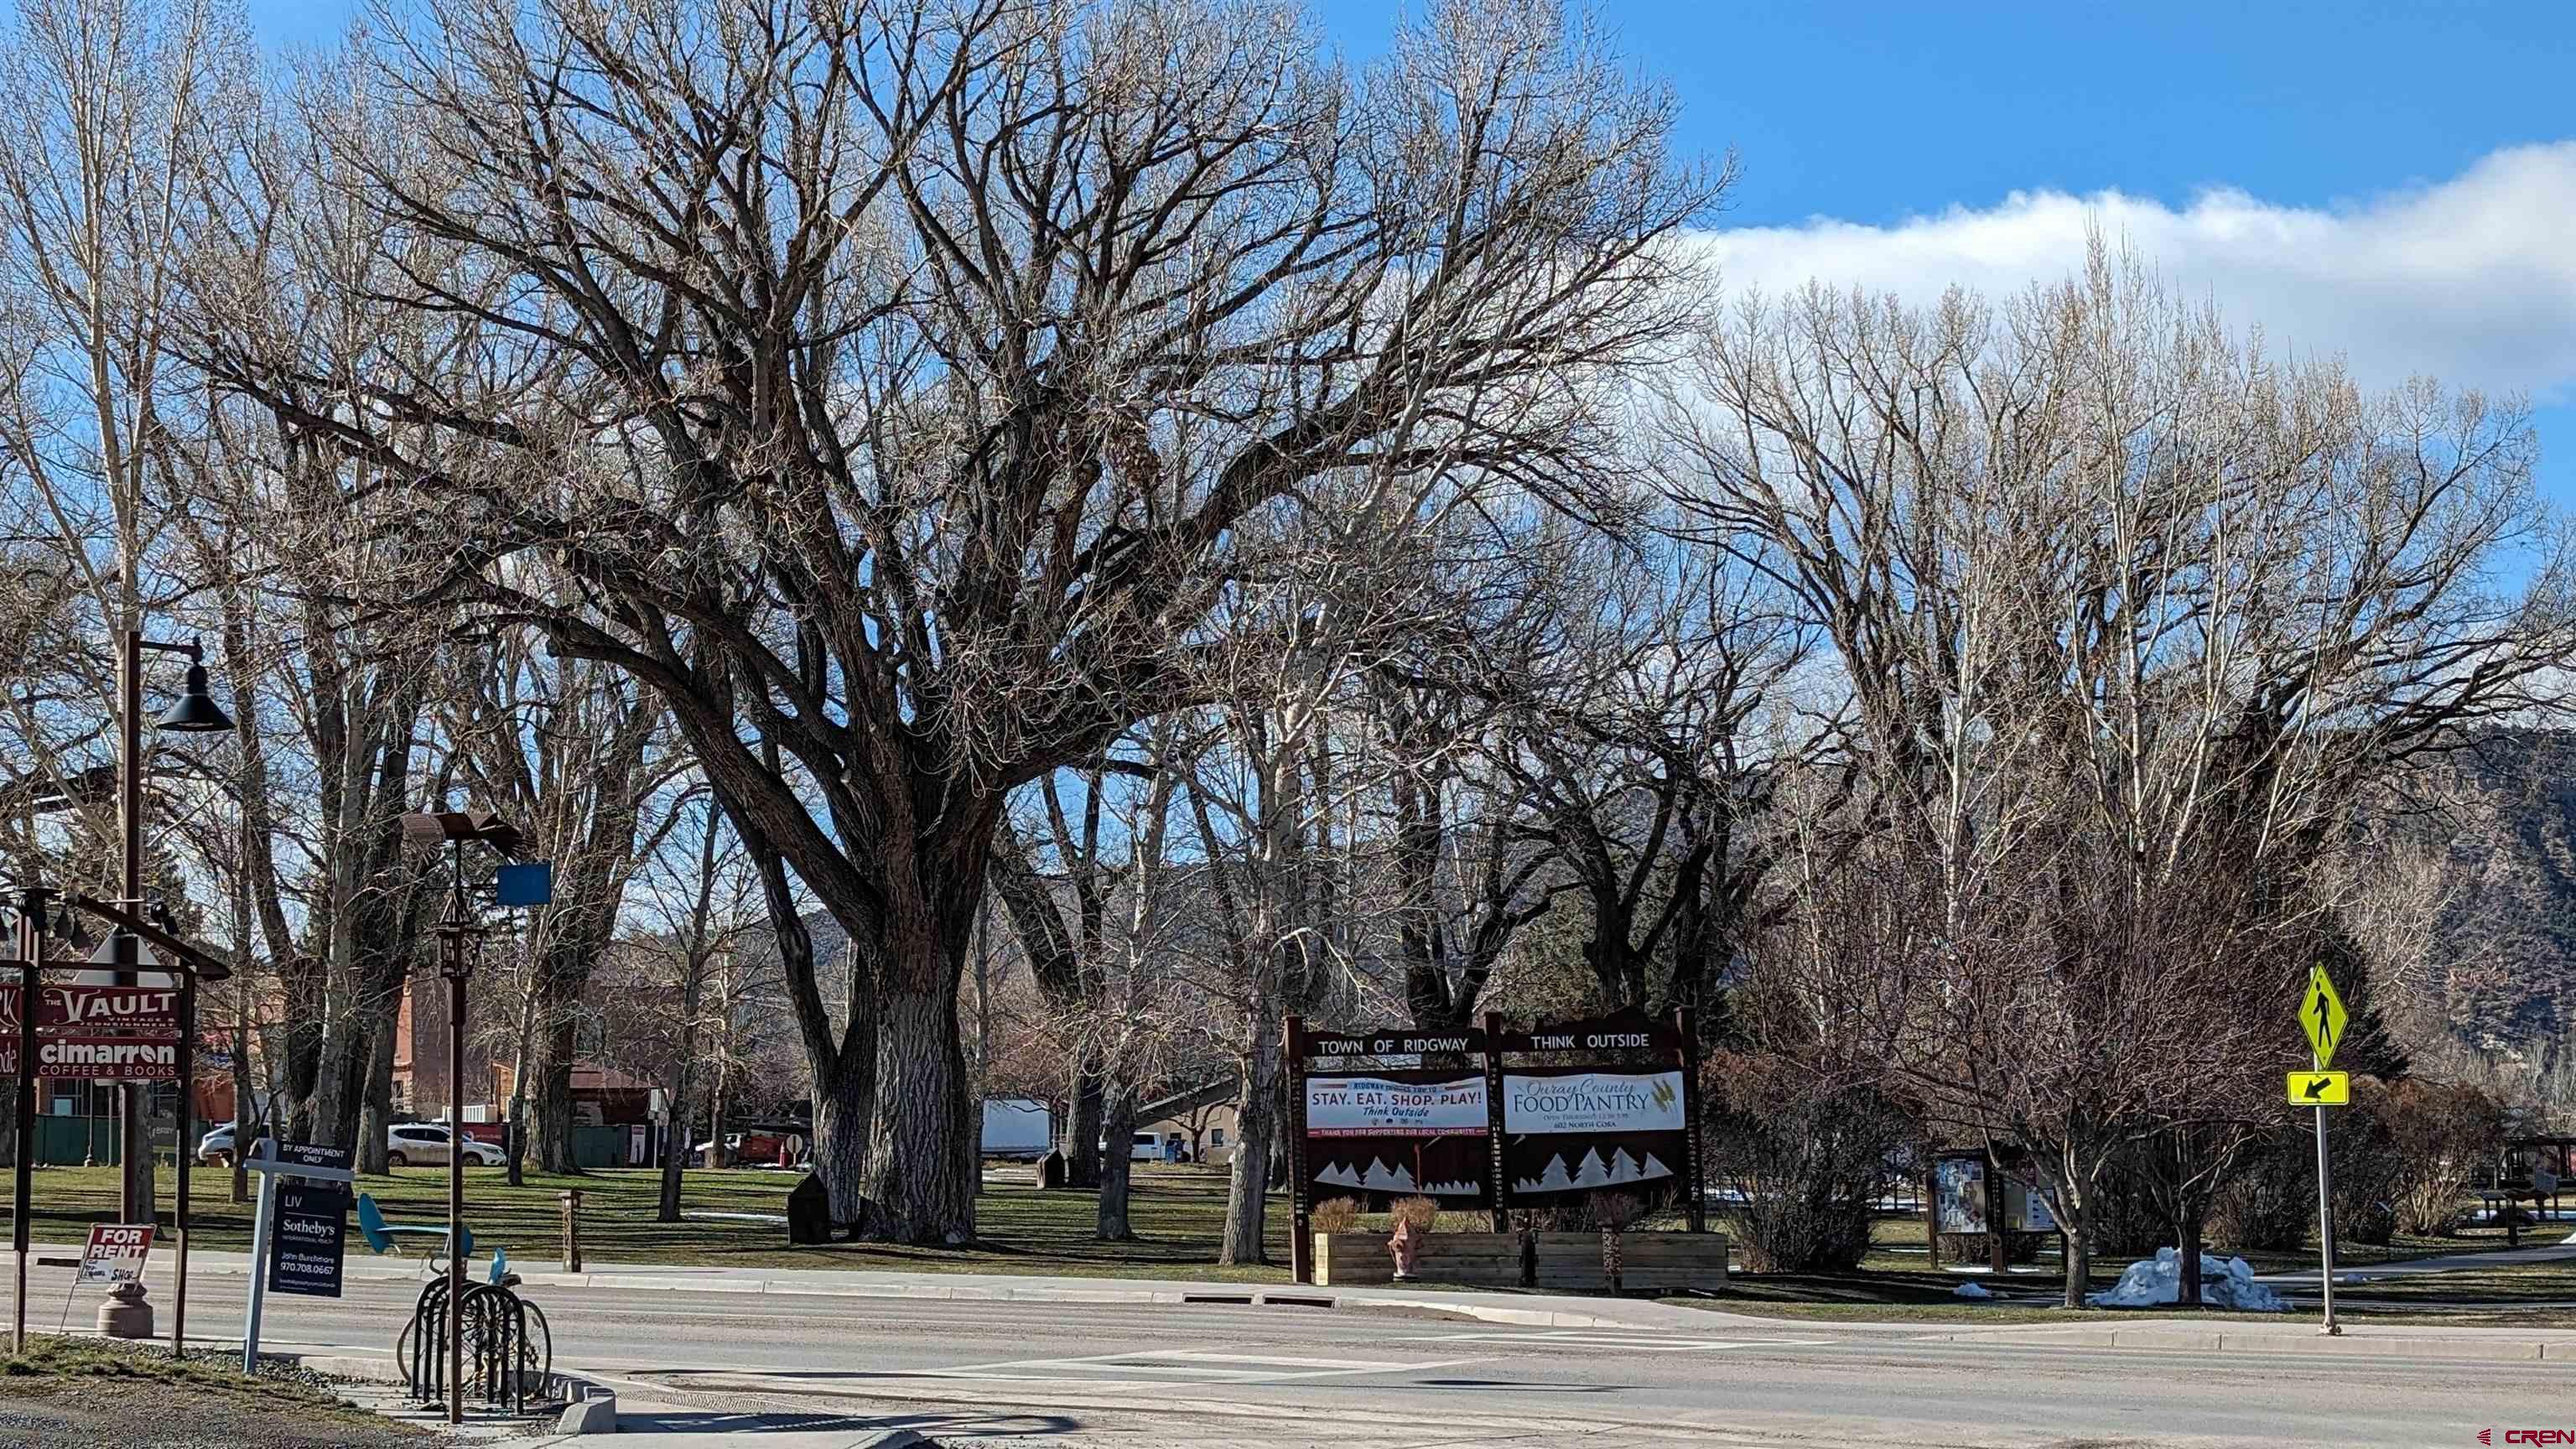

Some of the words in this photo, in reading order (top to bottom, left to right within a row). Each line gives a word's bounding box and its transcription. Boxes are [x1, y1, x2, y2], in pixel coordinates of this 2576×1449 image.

[42, 987, 176, 1026] VAULT
[1318, 1040, 1363, 1054] TOWN
[1374, 1039, 1394, 1053] OF
[1404, 1038, 1468, 1053] RIDGWAY
[1531, 1036, 1576, 1050] THINK
[1587, 1034, 1650, 1048] OUTSIDE
[39, 1039, 175, 1064] cimarron
[39, 1065, 101, 1076] COFFEE
[106, 1066, 115, 1076] &
[125, 1066, 175, 1077] BOOKS
[1526, 1080, 1576, 1099] Ouray
[1580, 1078, 1634, 1098] County
[1312, 1093, 1351, 1105] STAY.
[1357, 1093, 1387, 1105] EAT.
[1391, 1094, 1435, 1106] SHOP.
[1441, 1092, 1482, 1105] PLAY!
[1514, 1094, 1569, 1113] FOOD
[1574, 1093, 1649, 1111] PANTRY
[1363, 1106, 1389, 1116] Think
[1392, 1107, 1429, 1117] Outside
[294, 1145, 345, 1158] APPOINTMENT
[304, 1155, 324, 1164] ONLY
[285, 1195, 303, 1208] LIV
[283, 1219, 335, 1237] Sotheby's
[101, 1229, 143, 1244] FOR
[90, 1244, 145, 1259] RENT
